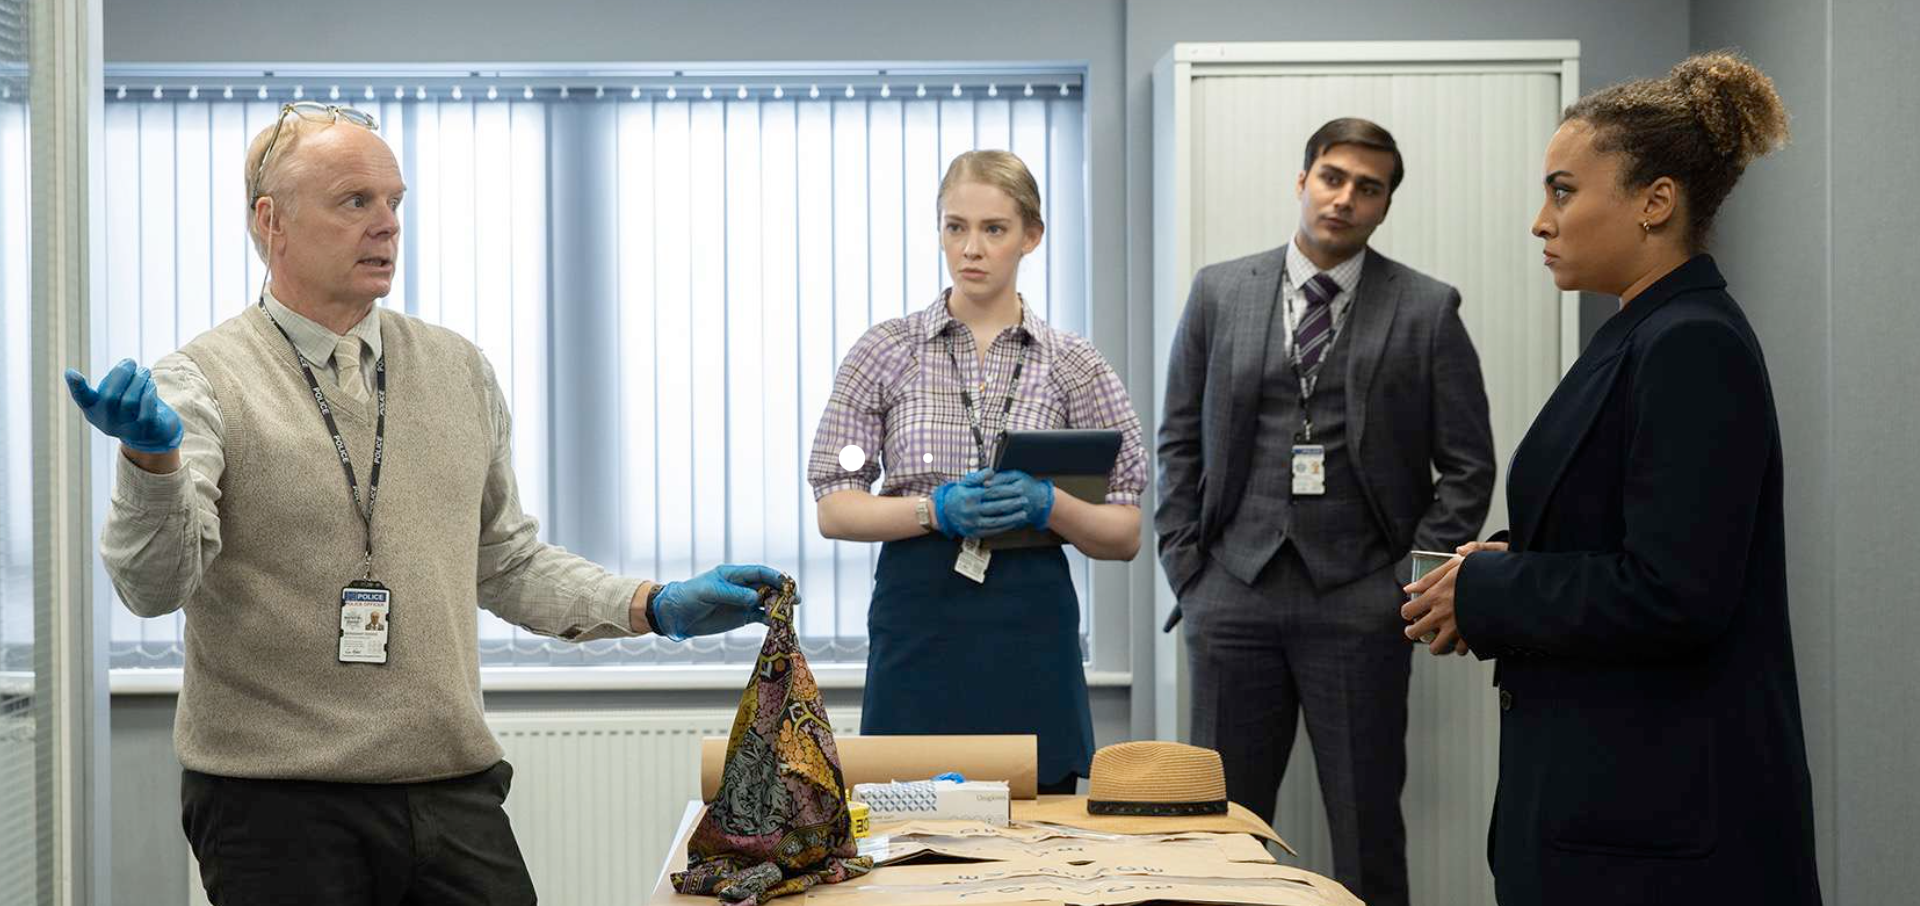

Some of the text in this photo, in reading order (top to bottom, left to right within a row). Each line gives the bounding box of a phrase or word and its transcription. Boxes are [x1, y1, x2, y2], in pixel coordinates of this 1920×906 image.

[312, 386, 330, 416] POLICE
[333, 434, 349, 463] POLICE
[373, 435, 383, 464] POLICE
